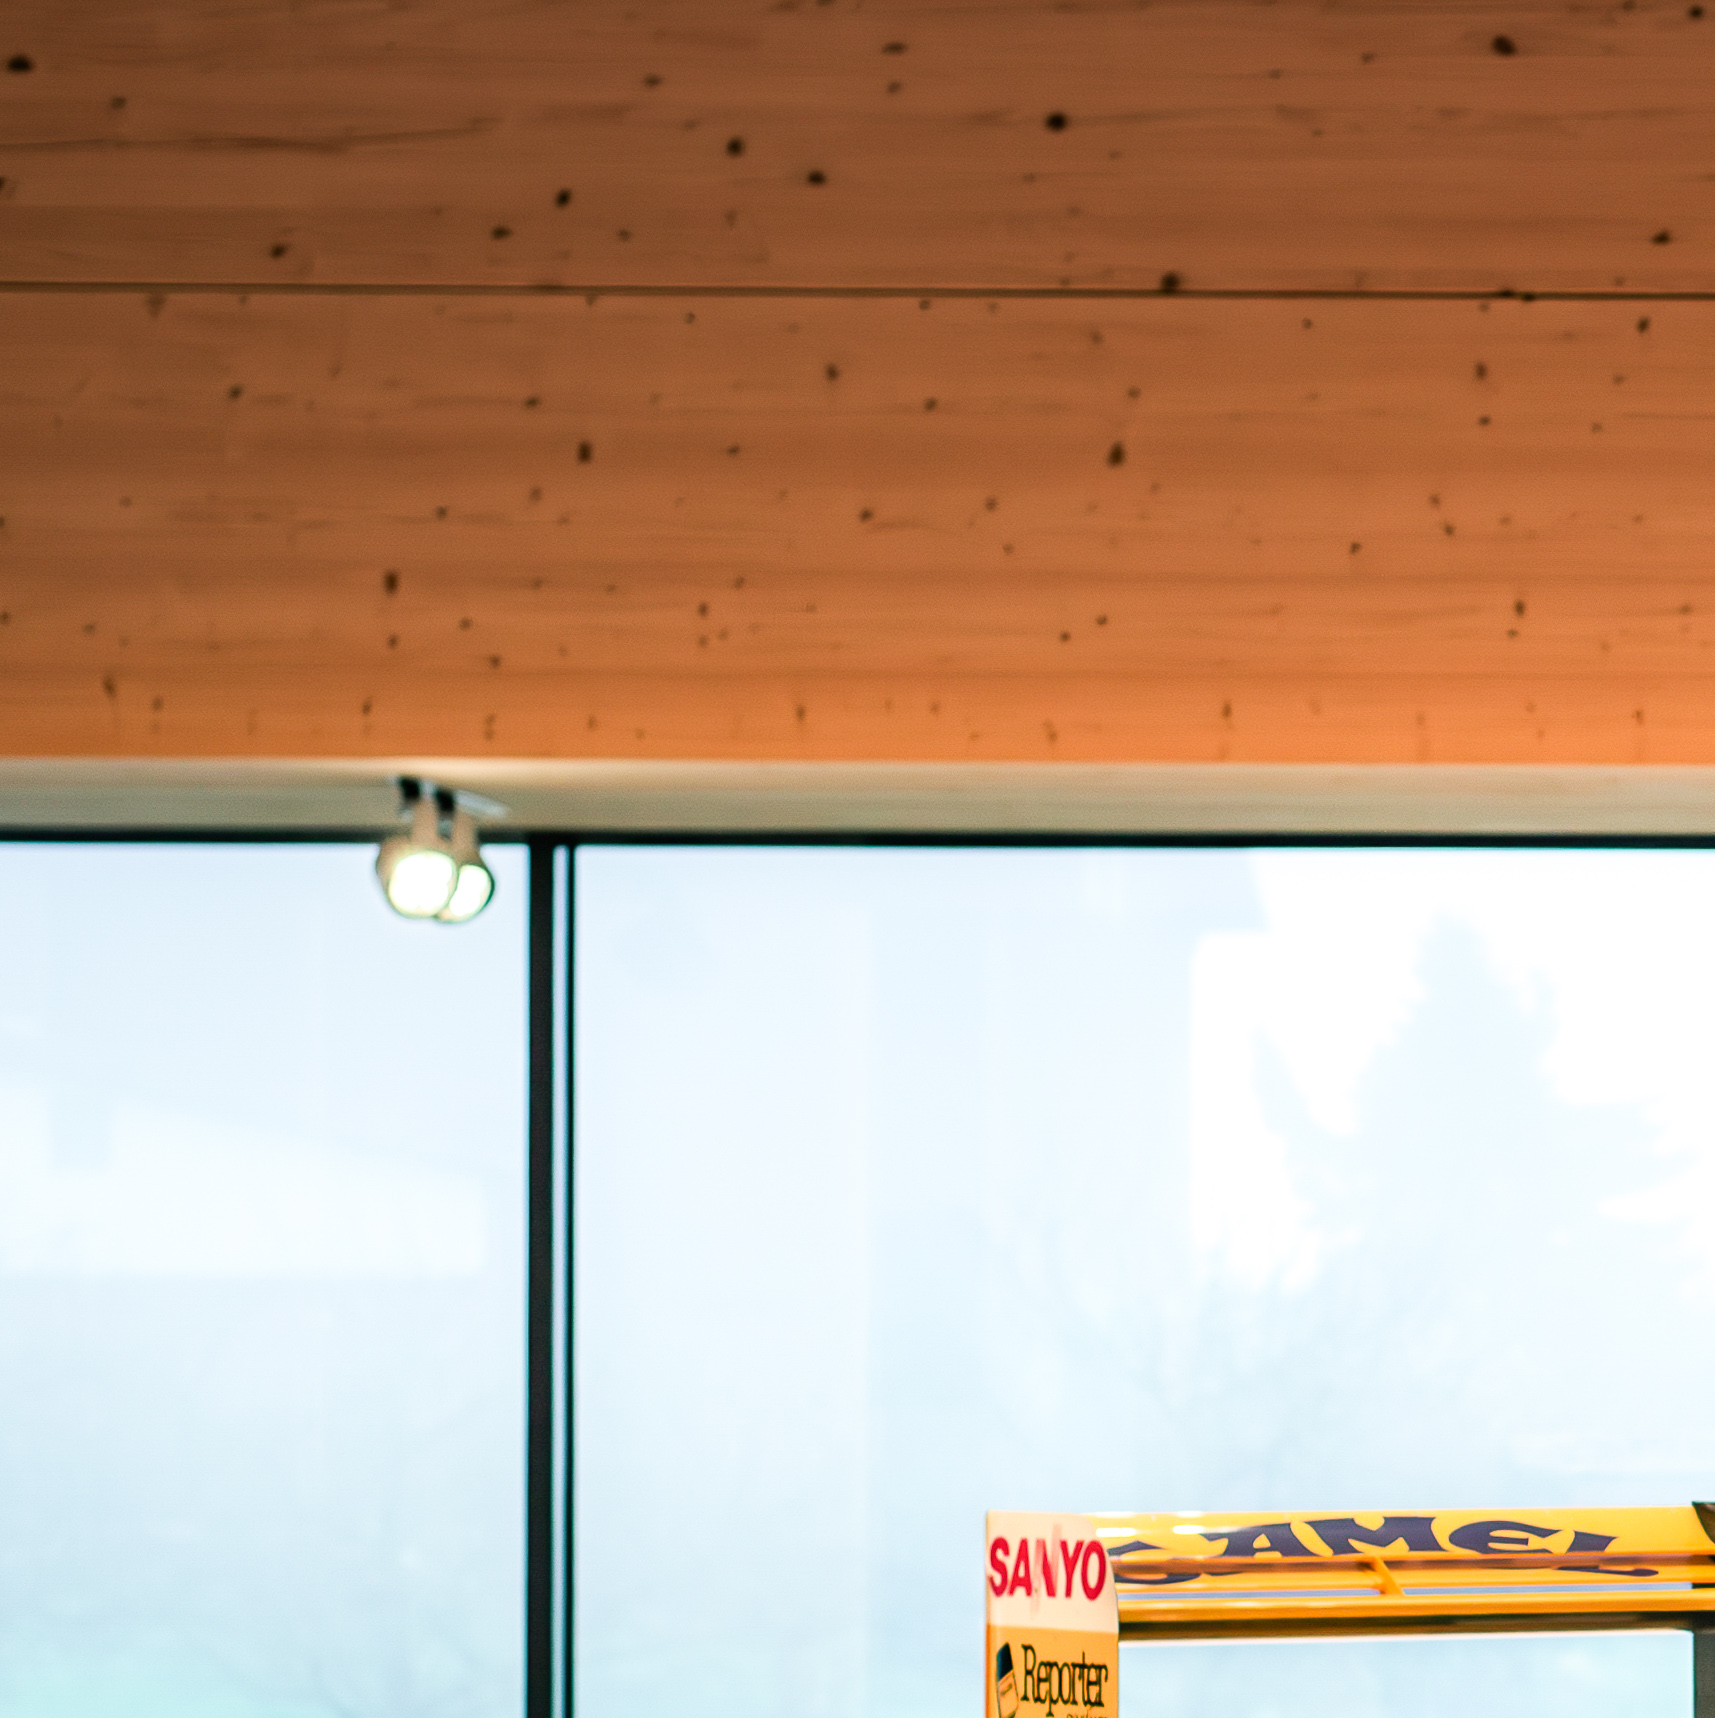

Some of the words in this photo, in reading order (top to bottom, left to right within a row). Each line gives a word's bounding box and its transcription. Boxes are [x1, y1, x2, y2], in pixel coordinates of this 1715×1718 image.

[987, 1537, 1107, 1601] SANYO
[1106, 1515, 1659, 1585] CAMEL
[1020, 1643, 1109, 1717] Reporter
